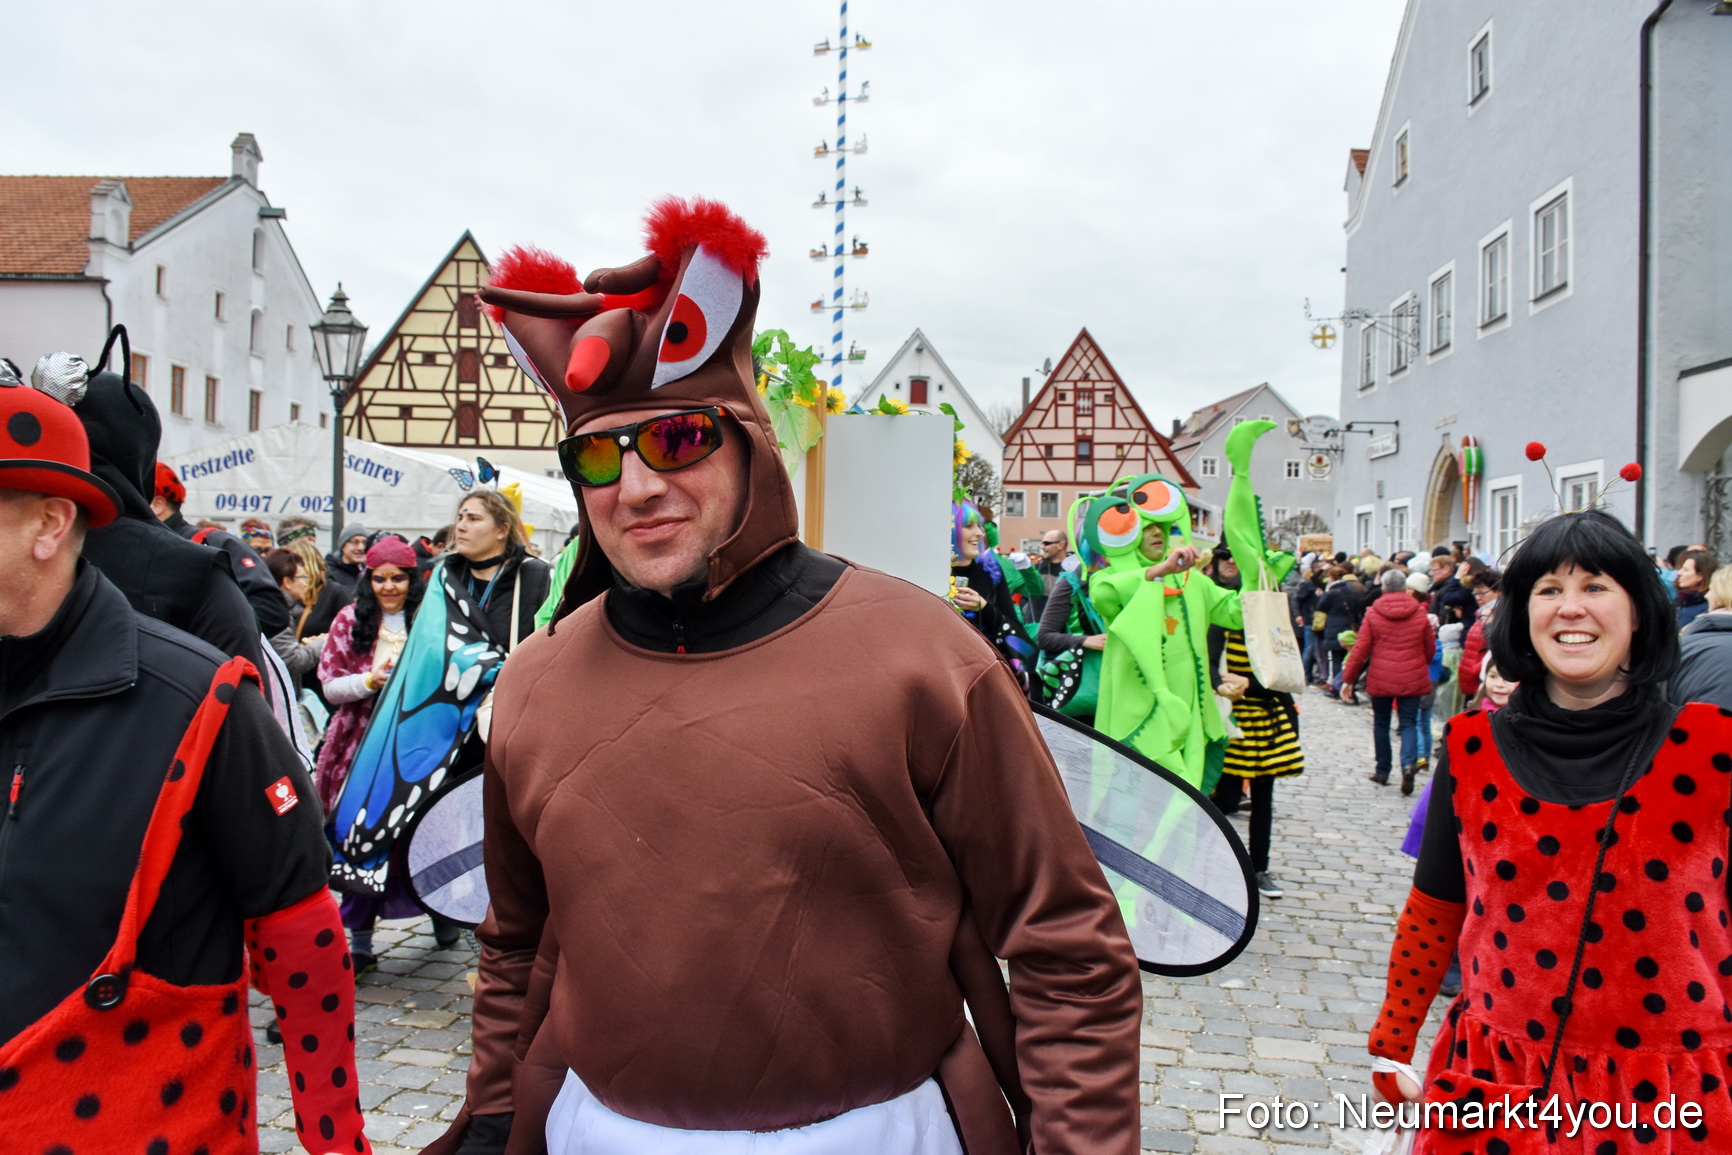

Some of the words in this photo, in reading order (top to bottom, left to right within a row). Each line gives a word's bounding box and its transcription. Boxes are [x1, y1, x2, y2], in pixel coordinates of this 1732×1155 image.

[180, 448, 255, 482] Festzelte
[216, 493, 272, 513] 09497
[279, 497, 291, 514] /
[300, 495, 367, 513] 90201
